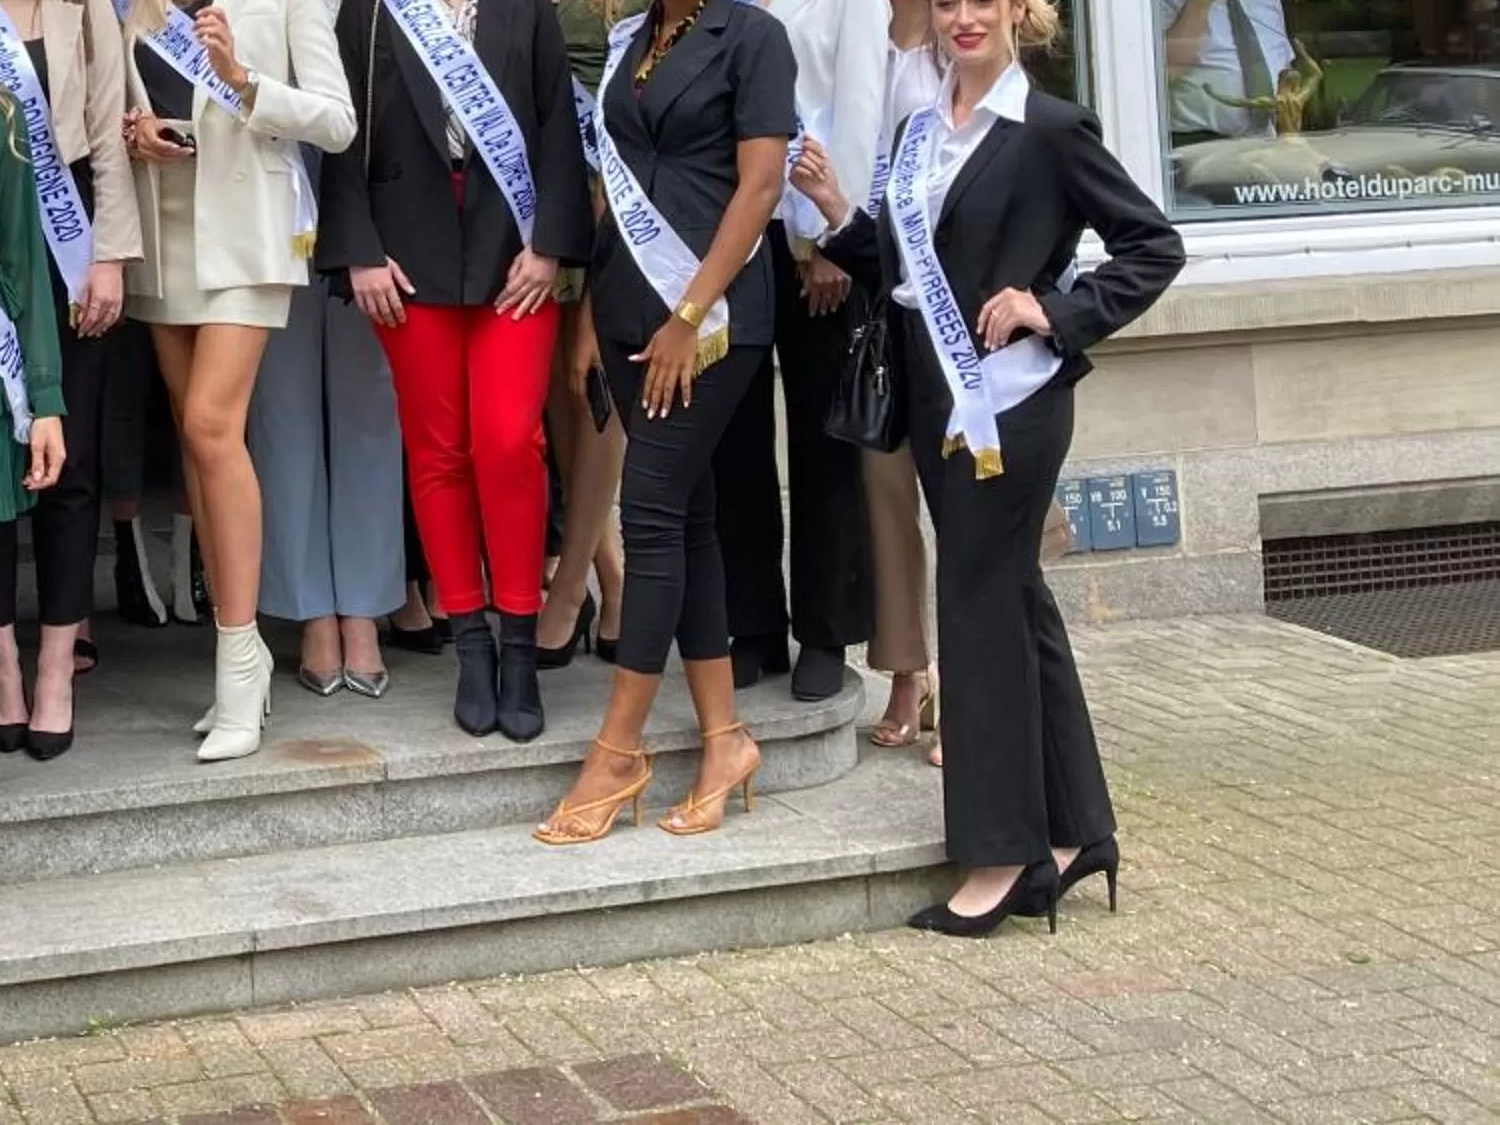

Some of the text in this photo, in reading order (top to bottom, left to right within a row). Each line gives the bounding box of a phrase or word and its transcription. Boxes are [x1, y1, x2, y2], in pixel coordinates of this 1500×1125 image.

[443, 62, 495, 115] CENTRE
[1234, 172, 1500, 203] www.hotelduparc-mu
[46, 201, 85, 243] 2020
[619, 202, 661, 246] 2020
[951, 345, 982, 391] 2020
